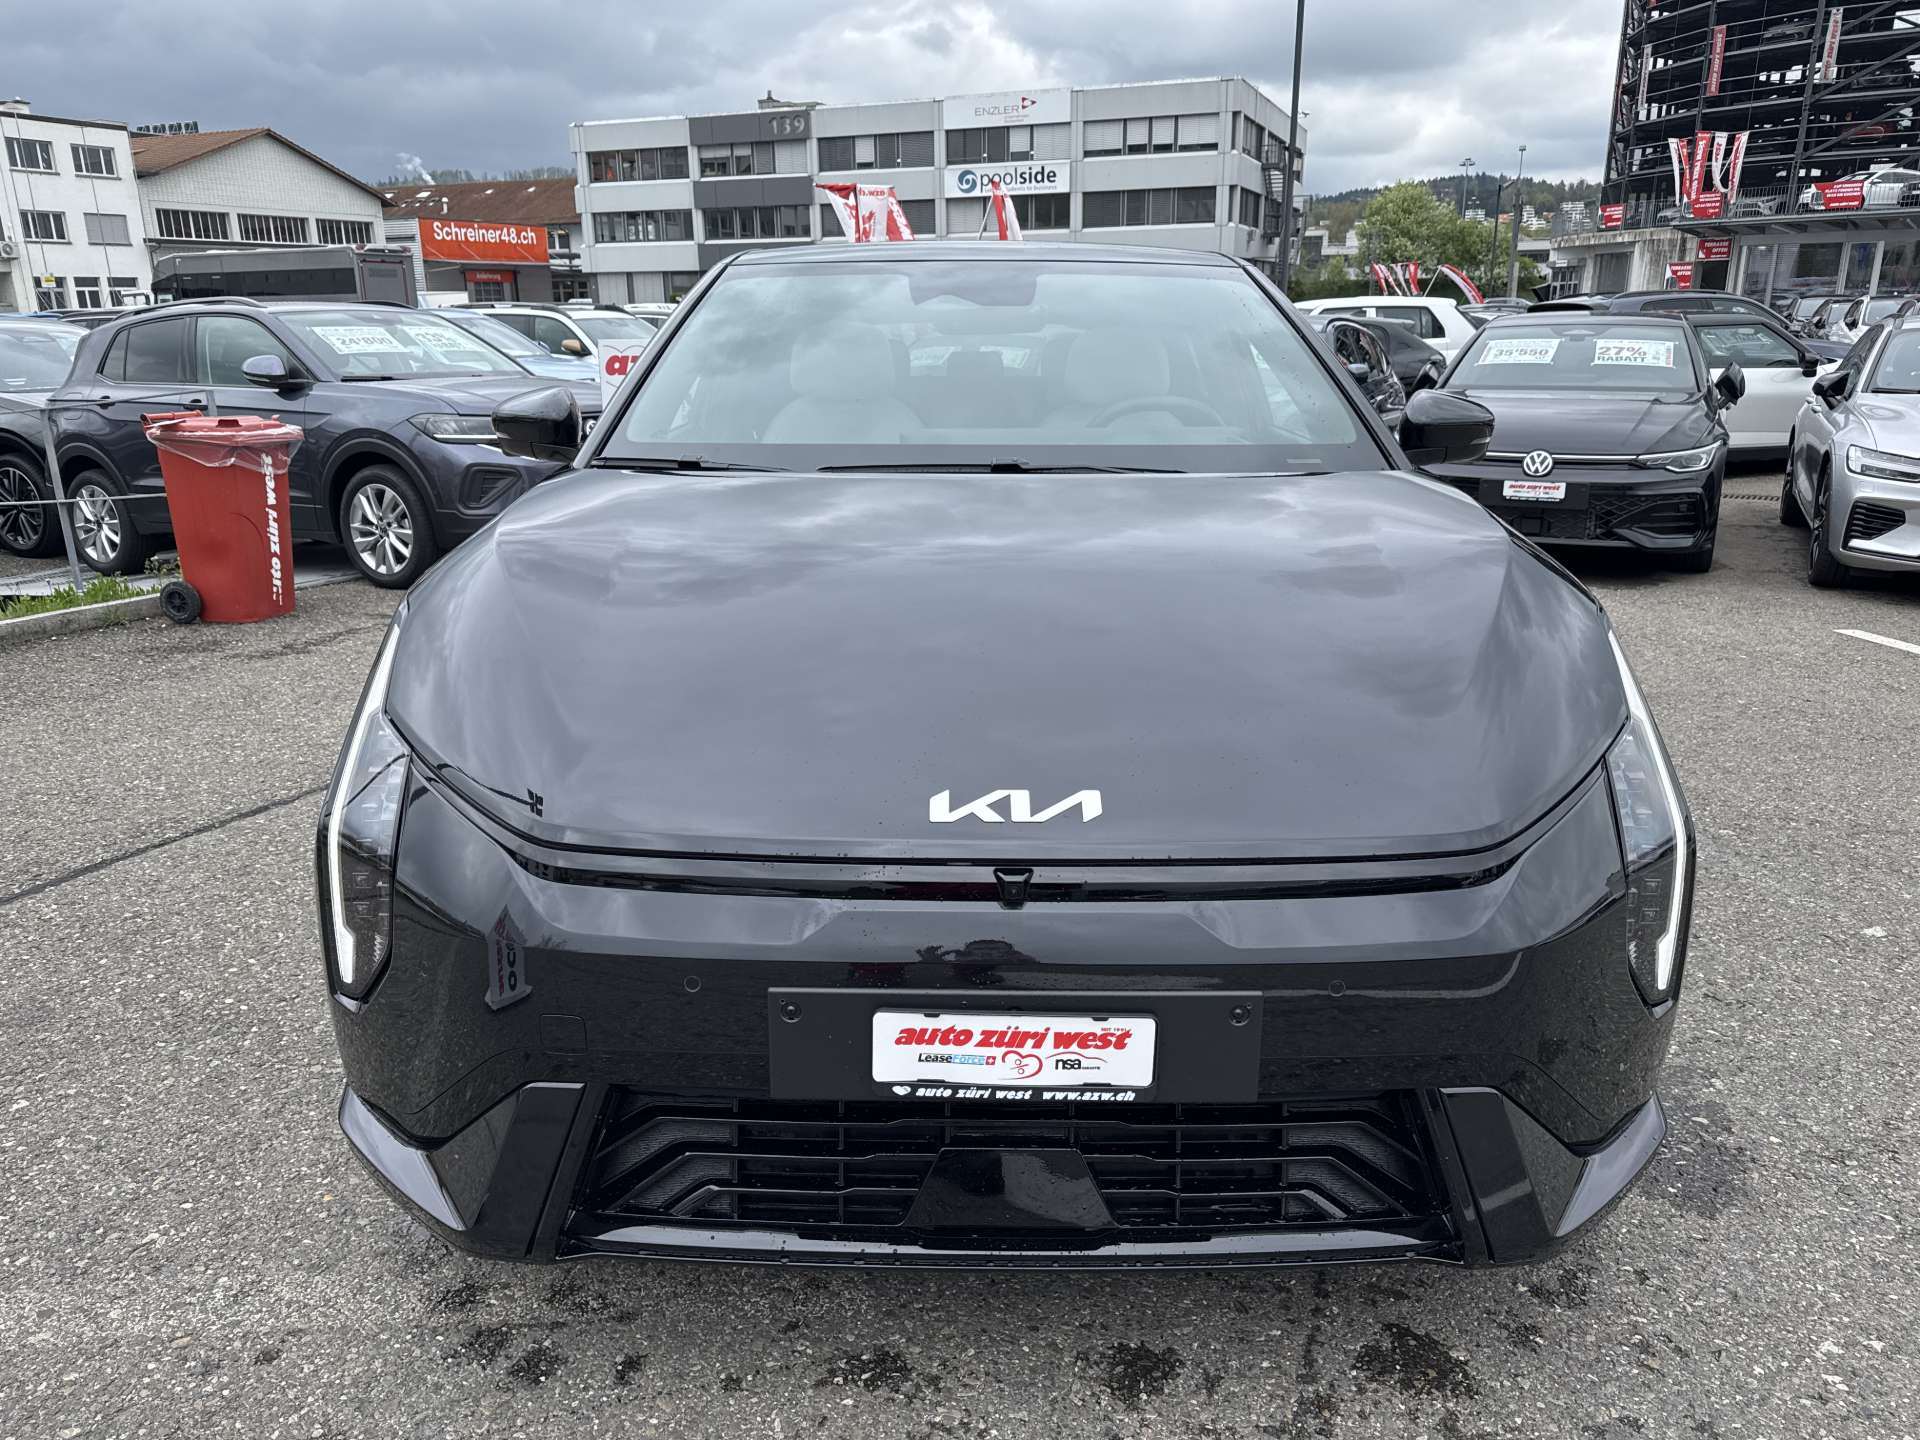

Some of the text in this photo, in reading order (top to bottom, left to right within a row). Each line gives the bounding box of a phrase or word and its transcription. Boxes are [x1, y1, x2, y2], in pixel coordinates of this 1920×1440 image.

[975, 104, 1019, 116] ENZLER
[770, 116, 805, 135] 139
[980, 166, 1057, 192] poolside
[433, 221, 537, 245] Schreiner48.ch
[1598, 345, 1647, 357] 27%
[894, 1024, 1133, 1050] auto züri west
[1055, 1057, 1082, 1070] nsa
[916, 1086, 1136, 1102] auto züri west www.azw.ch
